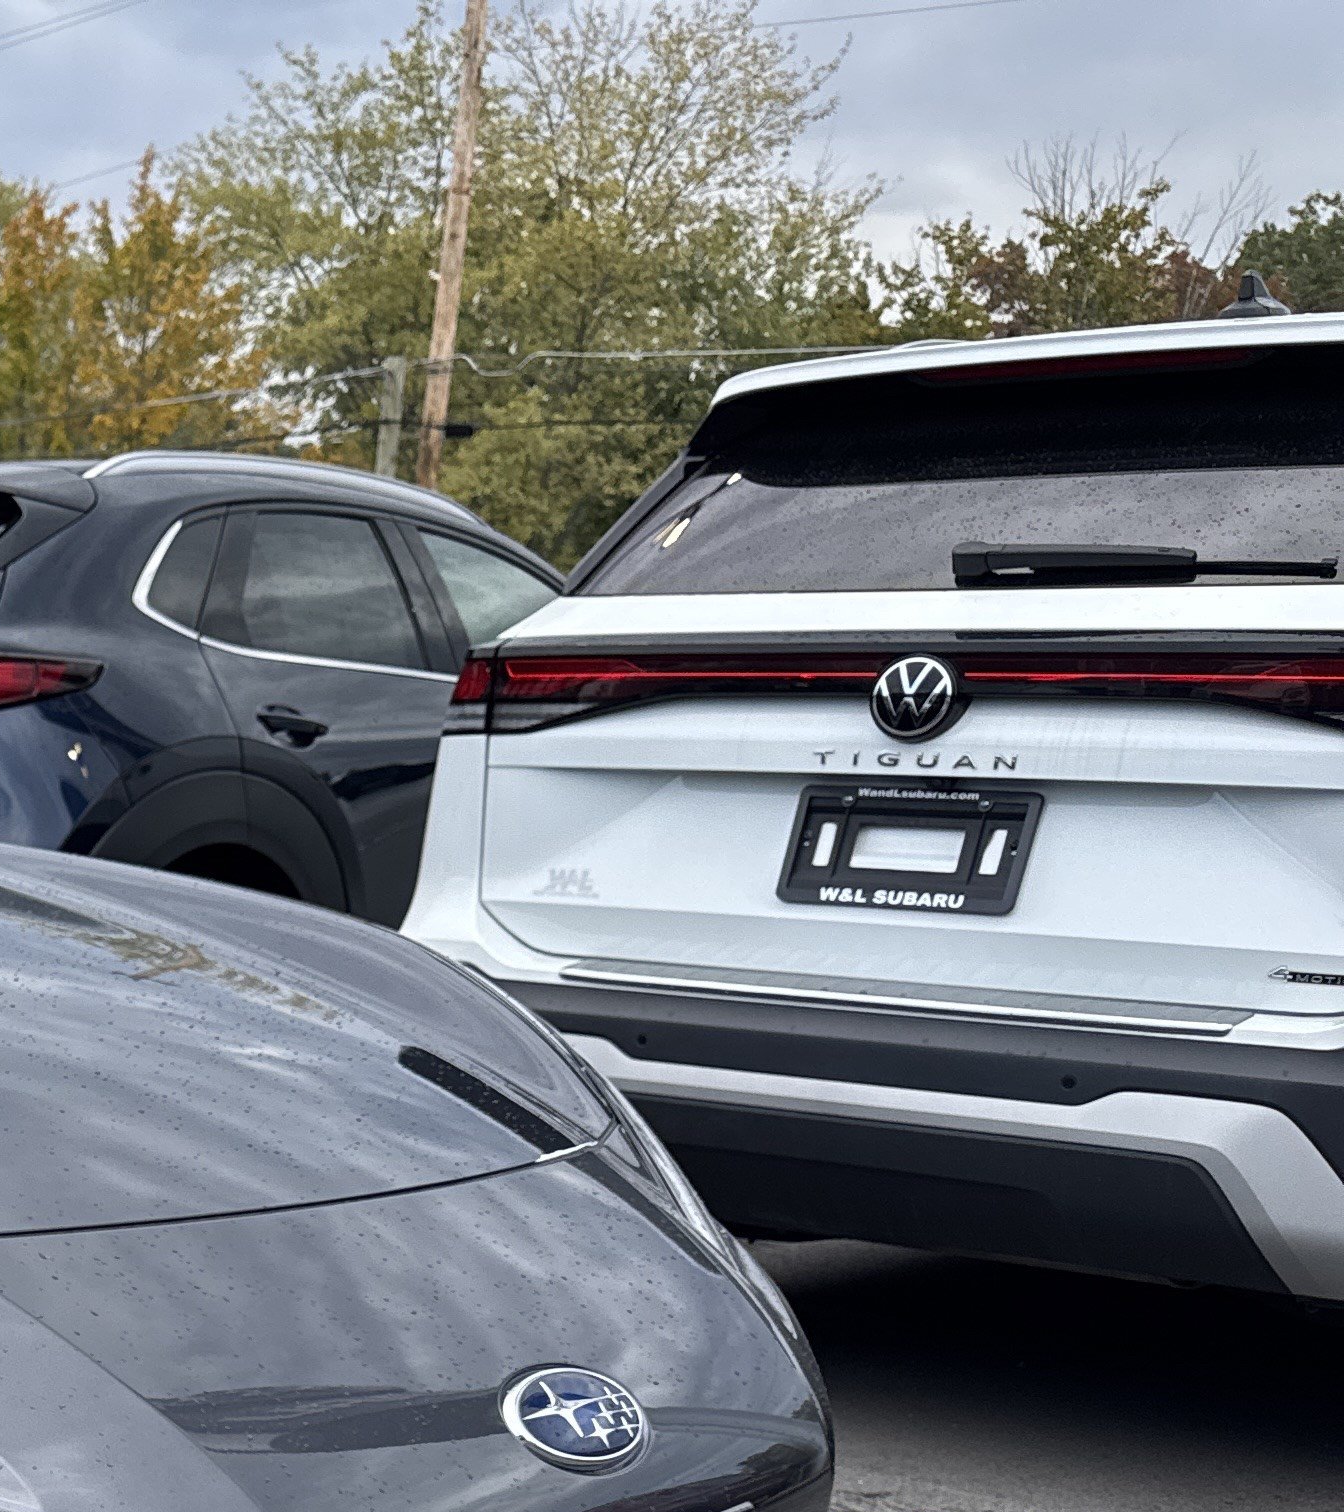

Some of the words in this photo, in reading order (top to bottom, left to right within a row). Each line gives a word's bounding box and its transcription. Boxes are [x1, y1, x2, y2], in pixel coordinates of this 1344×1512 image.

[813, 750, 1018, 771] TIGUAN
[819, 886, 867, 904] W&L
[872, 888, 965, 909] SUBARU
[1268, 965, 1344, 986] 4MOTI
